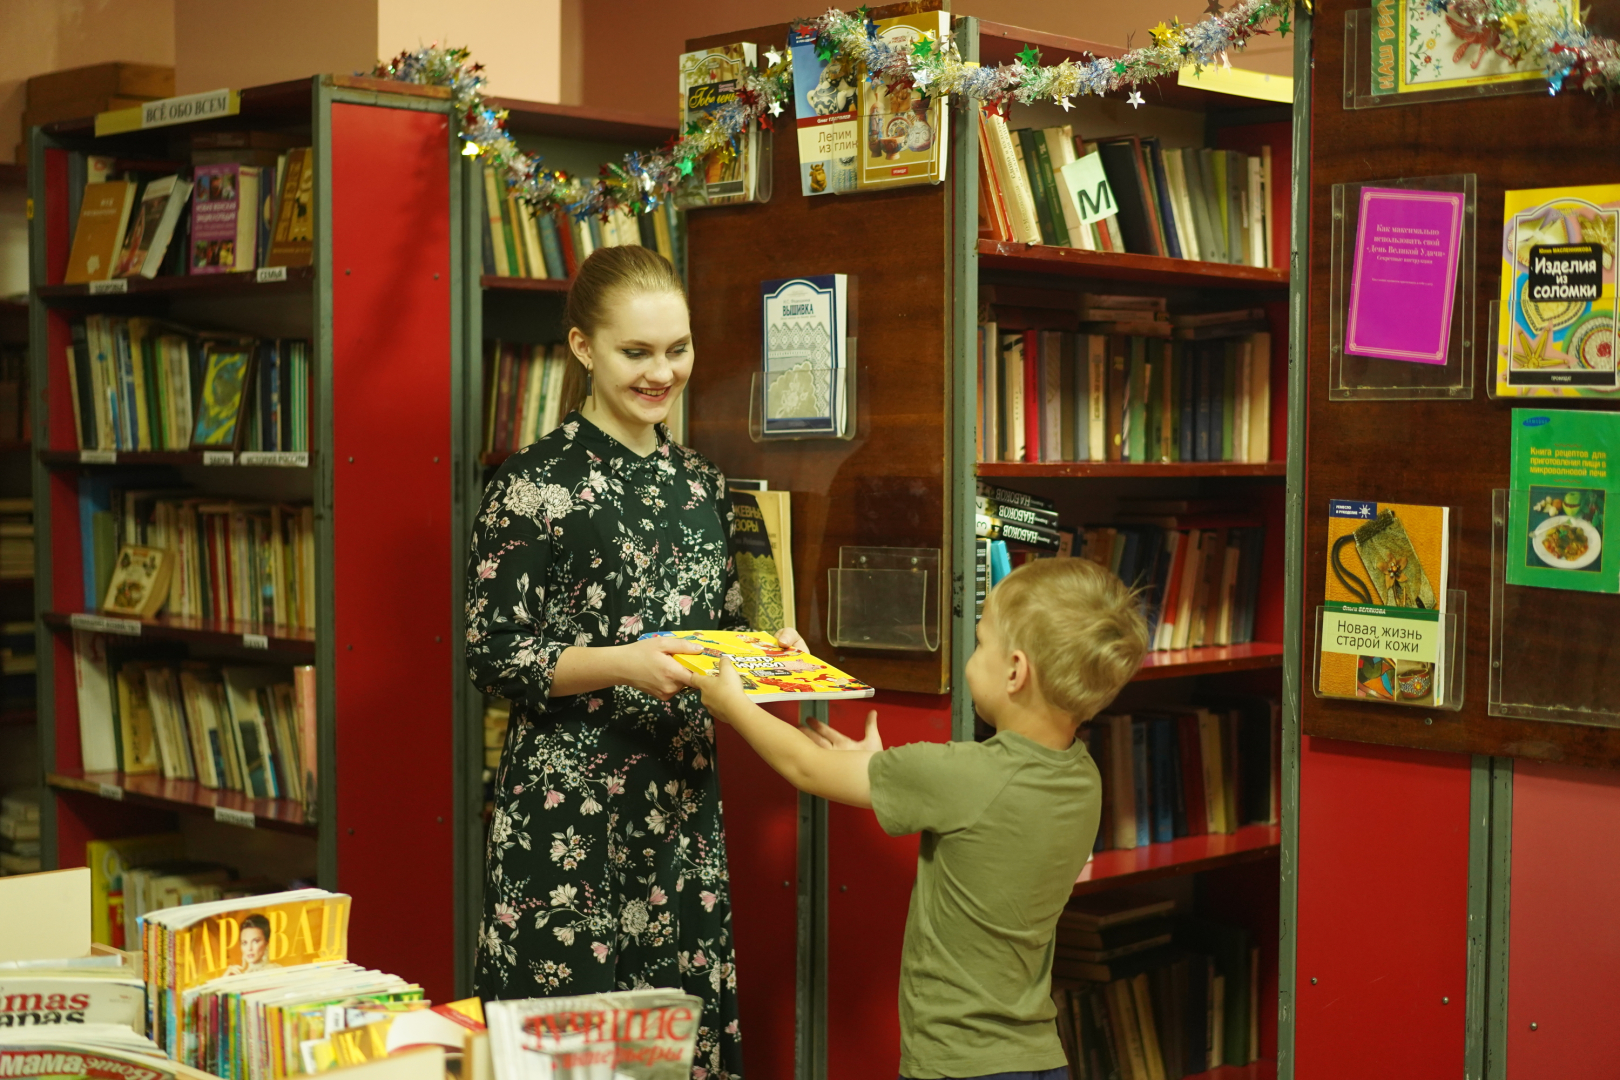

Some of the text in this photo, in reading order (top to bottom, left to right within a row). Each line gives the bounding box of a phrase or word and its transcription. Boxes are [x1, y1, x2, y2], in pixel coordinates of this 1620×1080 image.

[1378, 45, 1394, 89] НАШ
[169, 104, 192, 118] ОБО
[194, 97, 226, 115] ВСЕМ
[818, 130, 852, 144] Лепим
[819, 143, 832, 154] из
[1077, 180, 1111, 220] М
[1376, 224, 1439, 236] Как максимально
[1374, 236, 1440, 247] использовать свой
[1388, 245, 1419, 256] Великой
[1534, 256, 1597, 277] Изделия
[1556, 274, 1568, 285] из
[1533, 283, 1597, 299] соломки
[782, 303, 814, 317] ВЫШИВКА
[1530, 447, 1606, 461] Книга рецептов для
[1530, 457, 1580, 468] приготовления
[1582, 460, 1601, 469] пищи
[1529, 466, 1606, 477] микроволновой печи
[995, 488, 1031, 507] НАБОКОВ
[998, 505, 1035, 524] НАБОКОВ
[1002, 524, 1038, 544] НАБОКОВ
[1337, 620, 1422, 640] Новая жизнь
[1336, 634, 1419, 653] старой кожи
